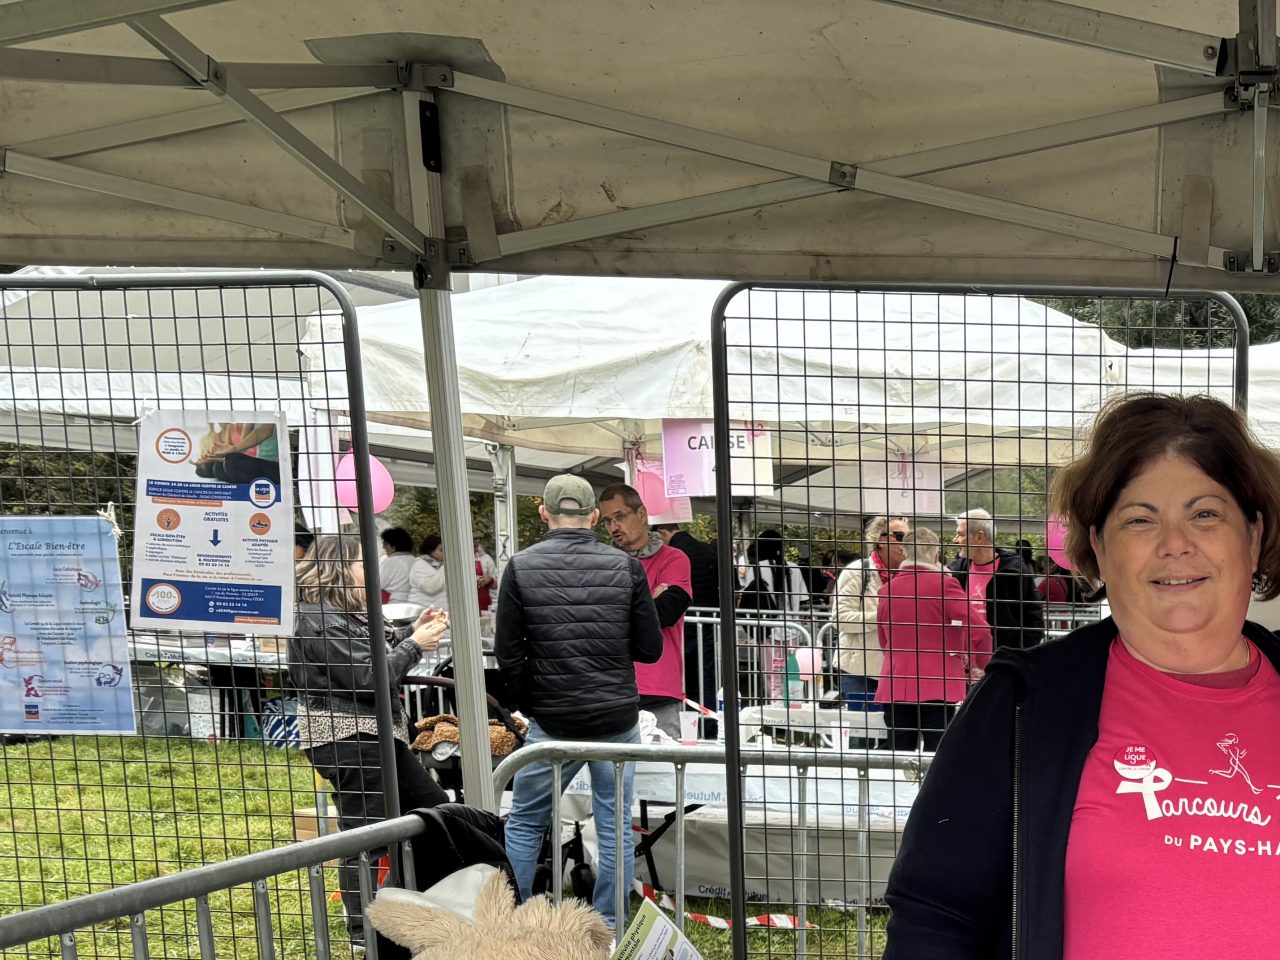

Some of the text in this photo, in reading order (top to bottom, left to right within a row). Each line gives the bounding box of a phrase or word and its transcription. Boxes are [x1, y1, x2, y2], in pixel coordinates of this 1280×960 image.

[687, 435, 746, 450] CAISE
[8, 541, 86, 551] L'Escale Bien-être
[1116, 767, 1272, 827] Parcours
[1164, 834, 1183, 847] DU
